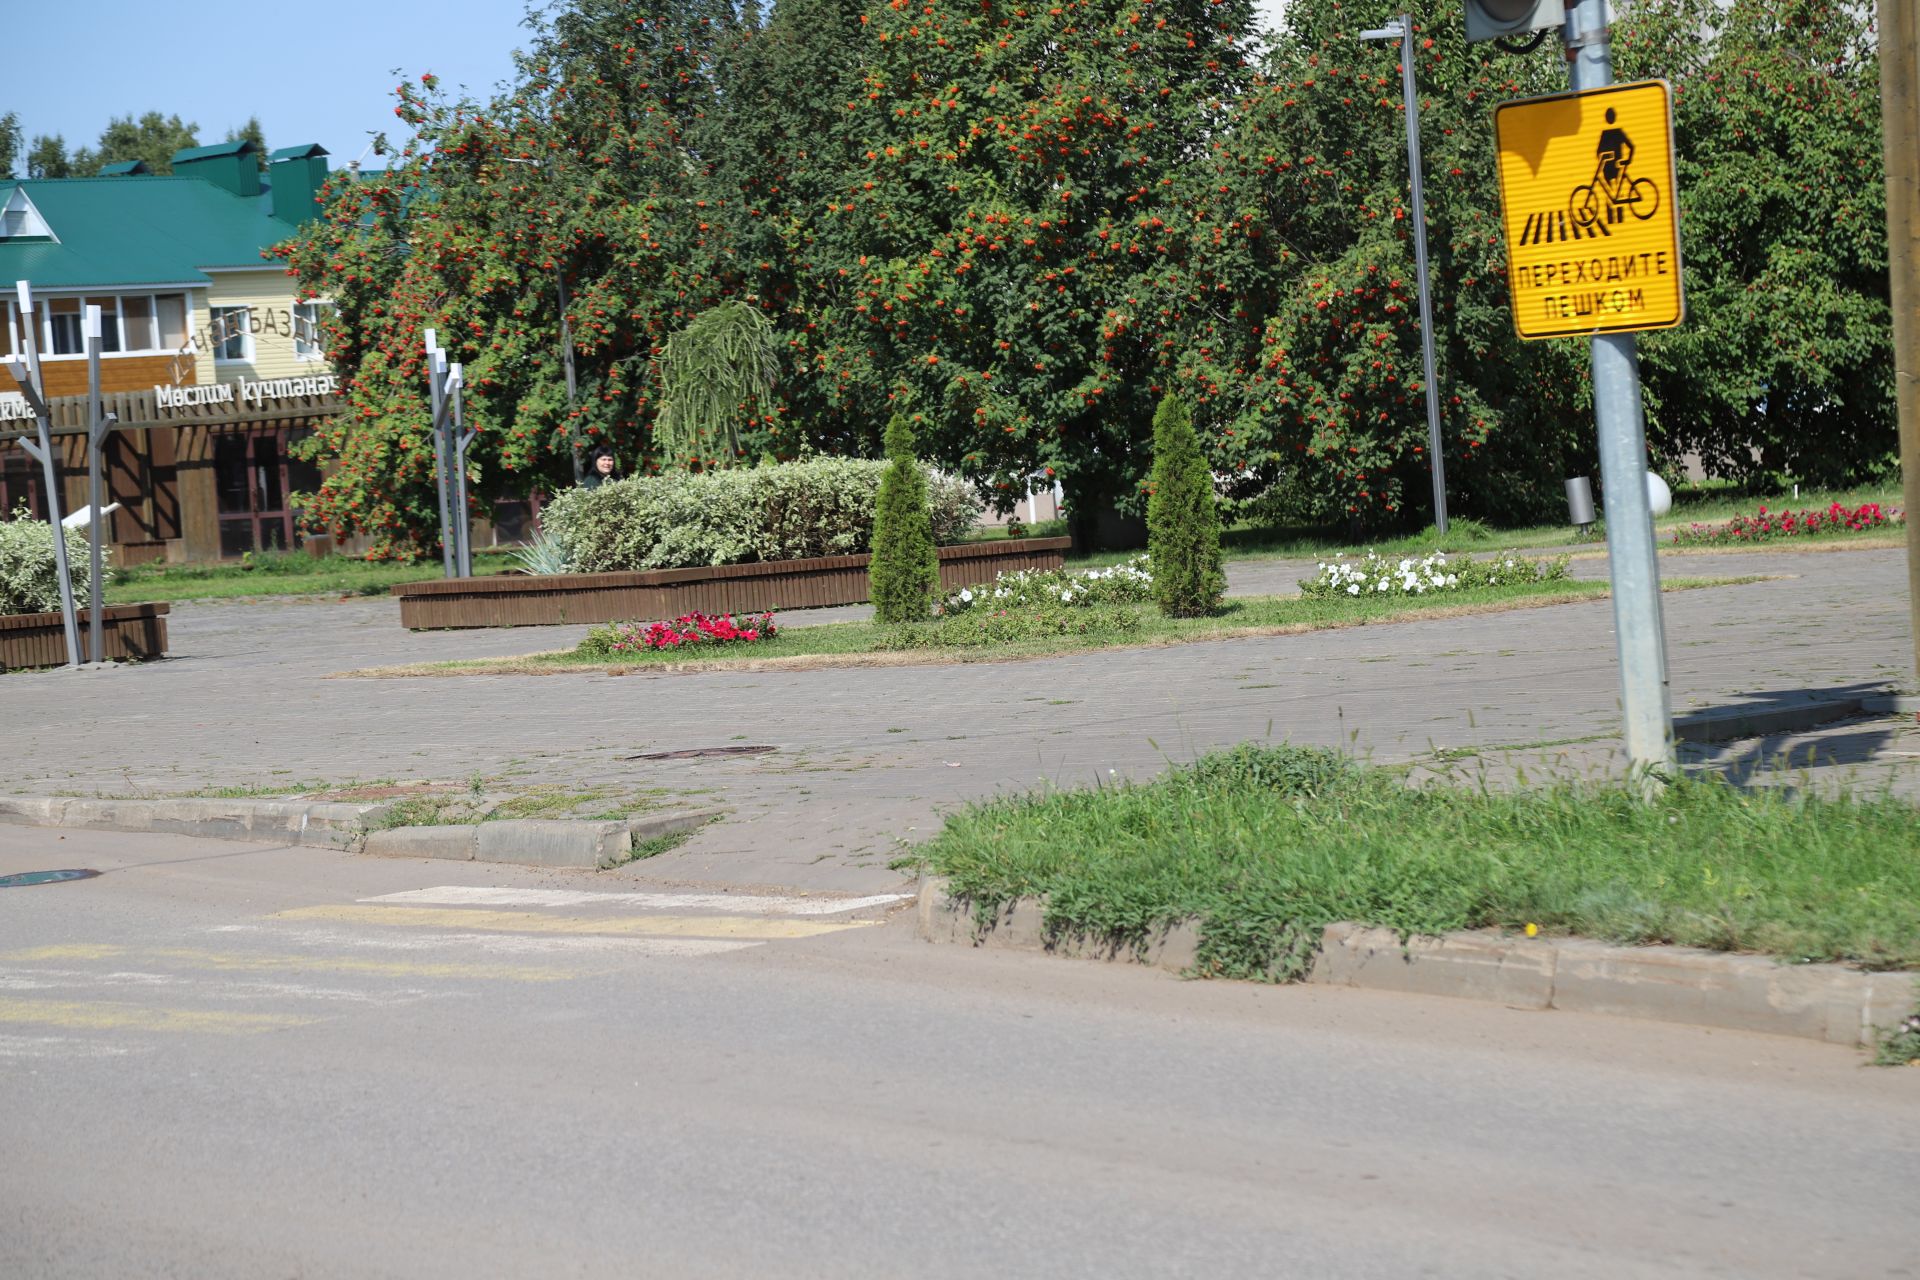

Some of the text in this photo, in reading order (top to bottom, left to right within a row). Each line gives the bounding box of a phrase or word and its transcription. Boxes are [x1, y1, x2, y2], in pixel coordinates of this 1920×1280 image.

[1519, 251, 1667, 288] ПЕРЕХОДИТЕ
[1545, 288, 1644, 318] ПЕШКОМ
[155, 383, 233, 408] Мөслим
